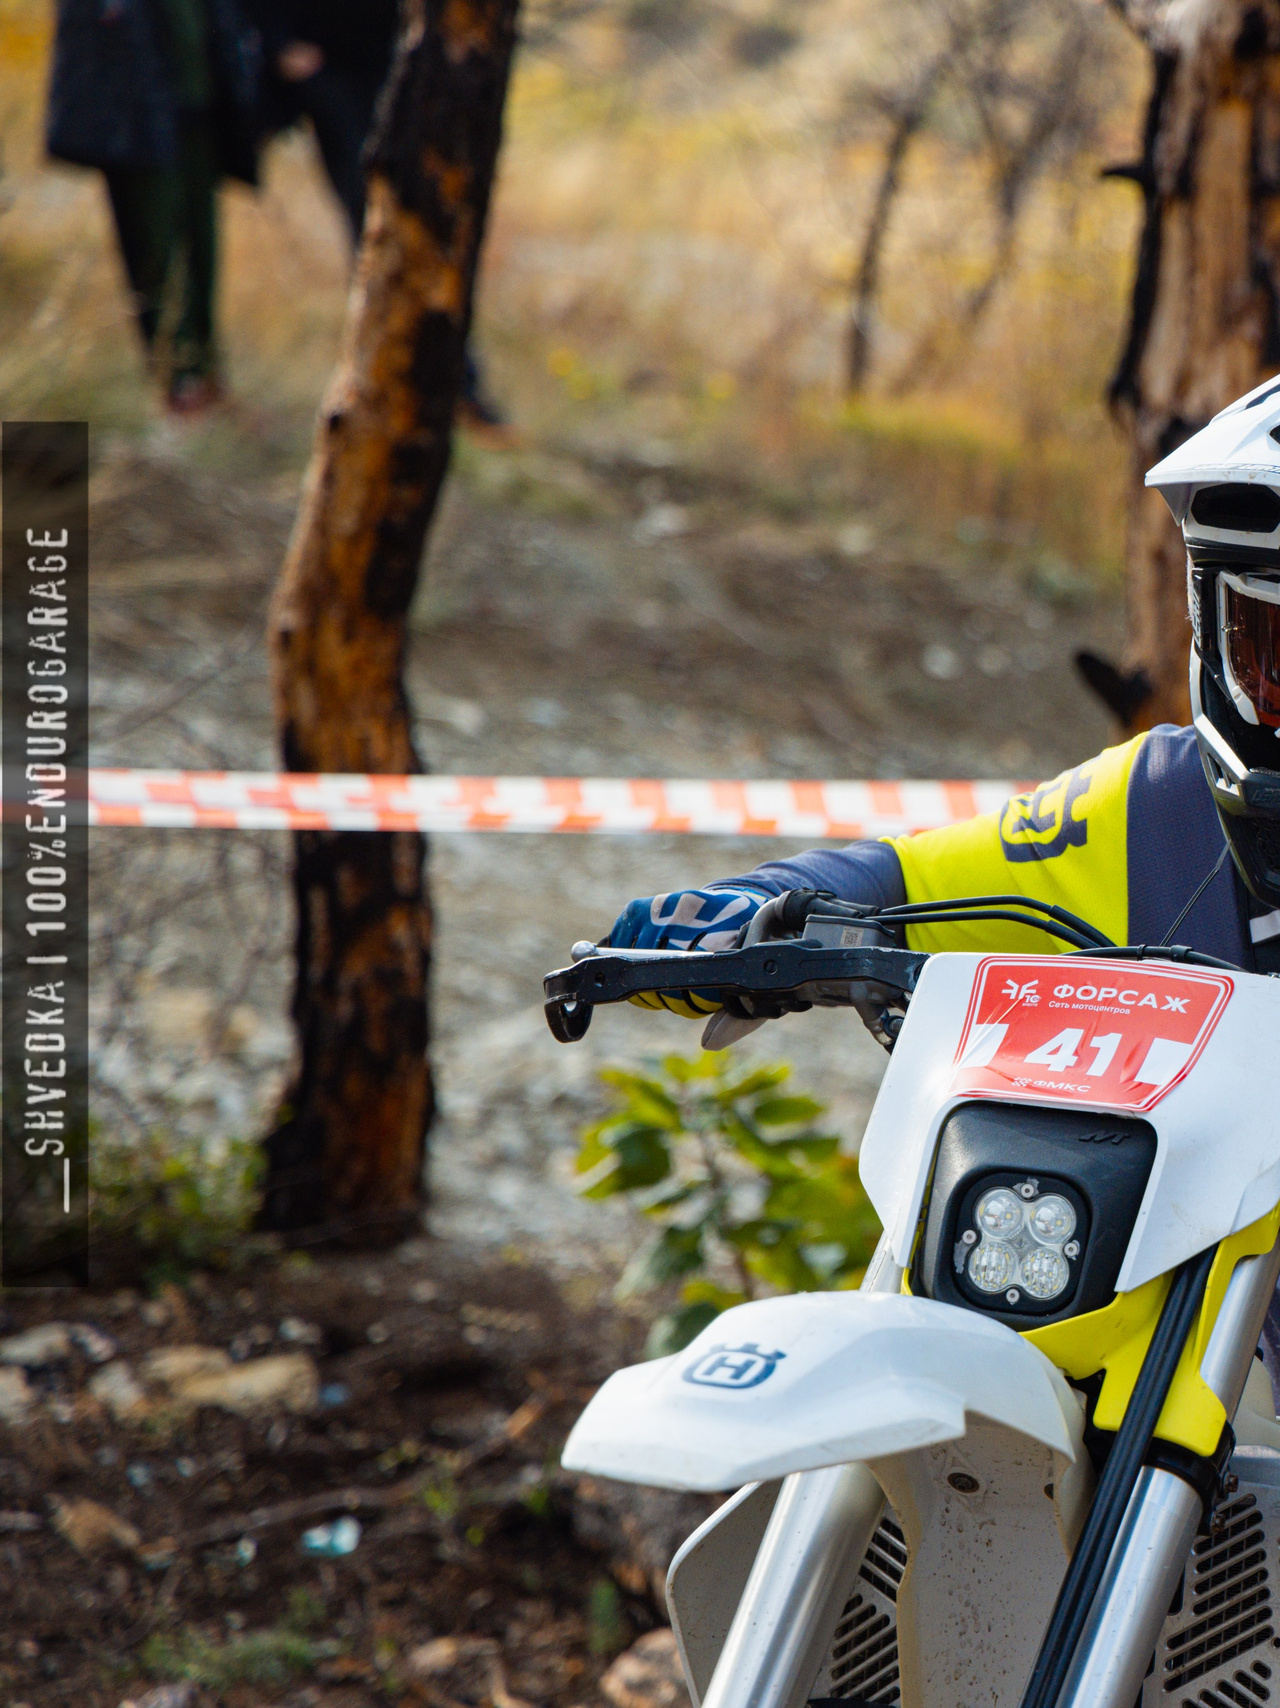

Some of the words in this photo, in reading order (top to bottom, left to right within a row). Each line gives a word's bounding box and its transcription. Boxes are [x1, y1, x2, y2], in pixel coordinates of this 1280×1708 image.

[1048, 1000, 1070, 1009] Сеть
[1071, 1003, 1131, 1015] мотоцентров
[1053, 983, 1191, 1014] ФОРСАЖ
[1024, 1027, 1123, 1077] 41
[1033, 1080, 1091, 1093] ФМКС
